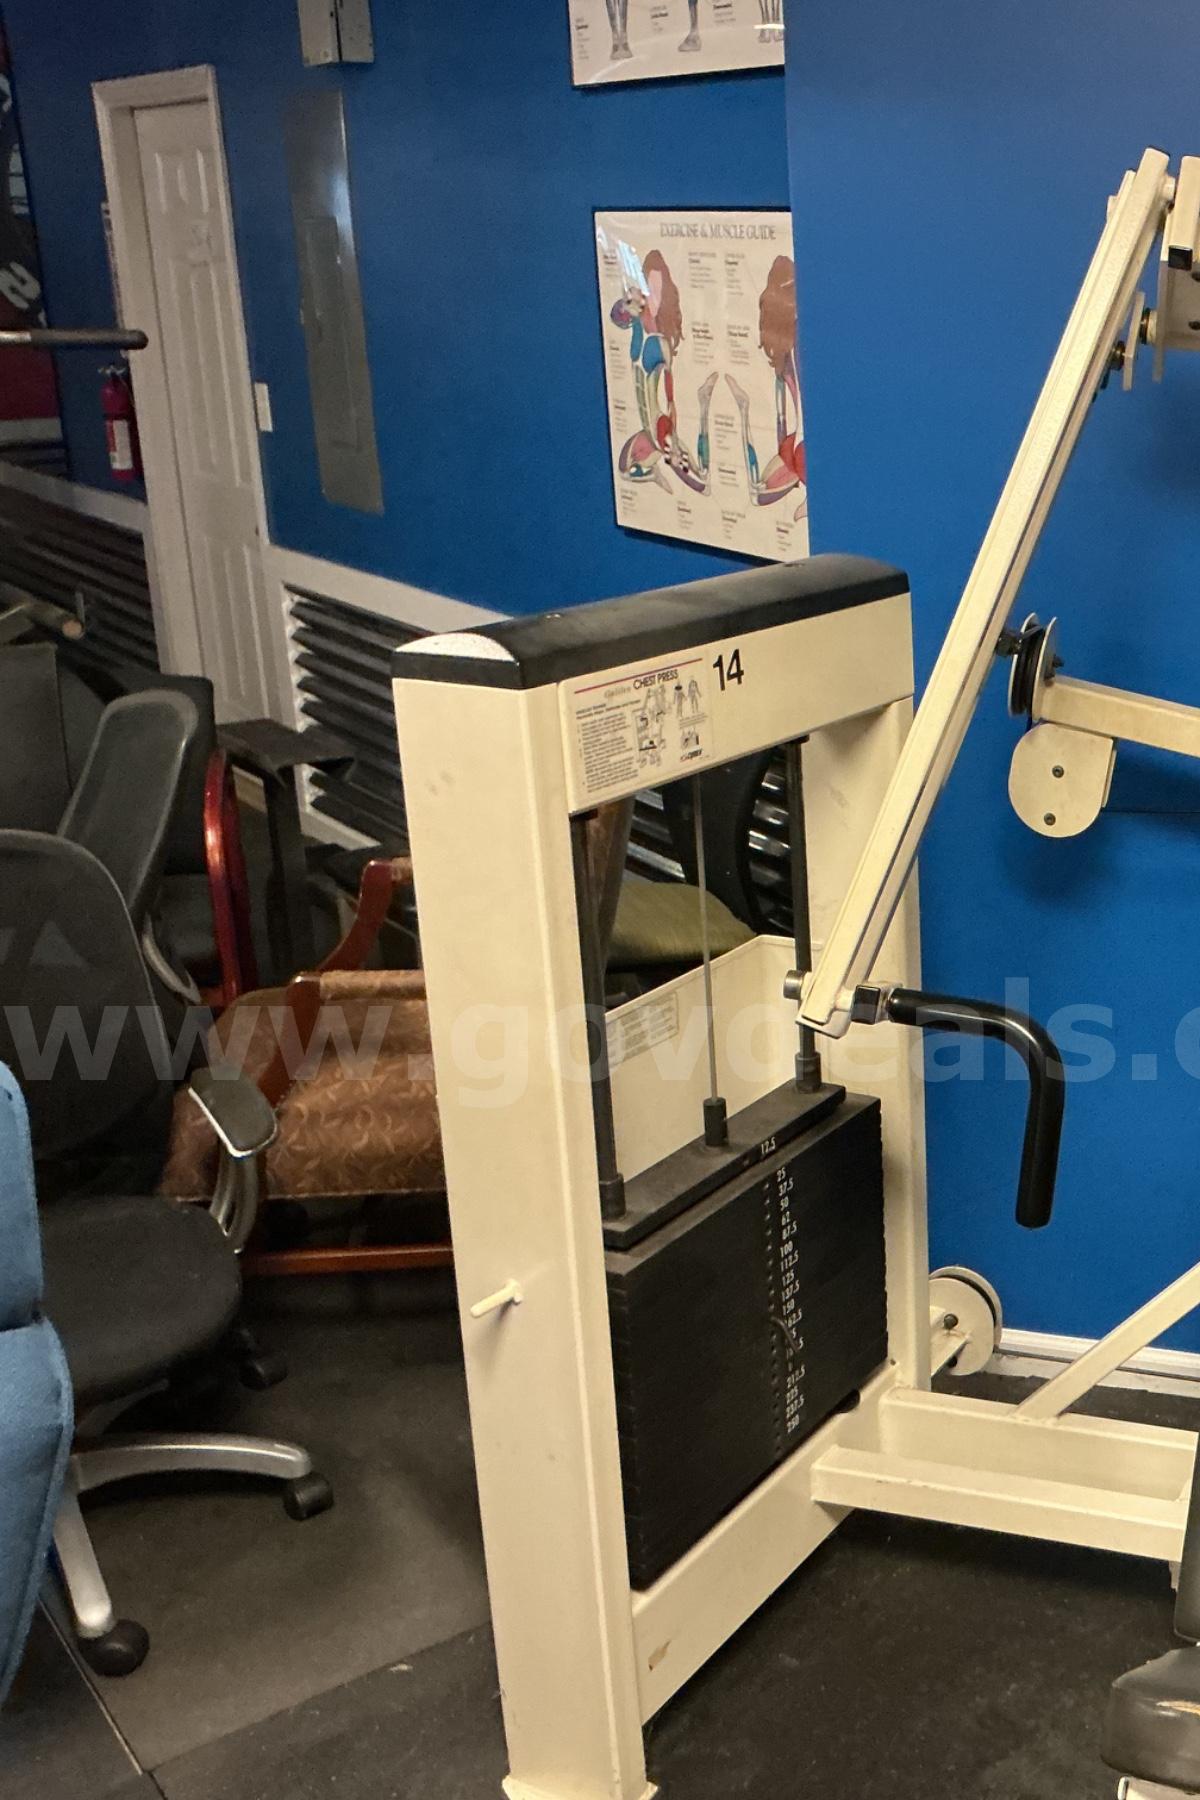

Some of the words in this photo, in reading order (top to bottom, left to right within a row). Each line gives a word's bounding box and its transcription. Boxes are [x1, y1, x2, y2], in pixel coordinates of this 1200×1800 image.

[710, 224, 745, 239] MUSCLE
[746, 225, 776, 240] GUIDE
[713, 648, 744, 691] 14
[632, 675, 656, 690] CHEST
[657, 669, 679, 683] PRESS
[776, 1166, 786, 1182] 25
[778, 1177, 794, 1196] 37.5
[780, 1196, 789, 1211] 50
[780, 1240, 793, 1258] 100
[780, 1249, 799, 1272] 112.5
[782, 1269, 795, 1287] 125
[781, 1279, 800, 1302] 137.5
[782, 1298, 795, 1316] 150
[786, 1394, 805, 1419] 237.5
[786, 1414, 800, 1434] 250
